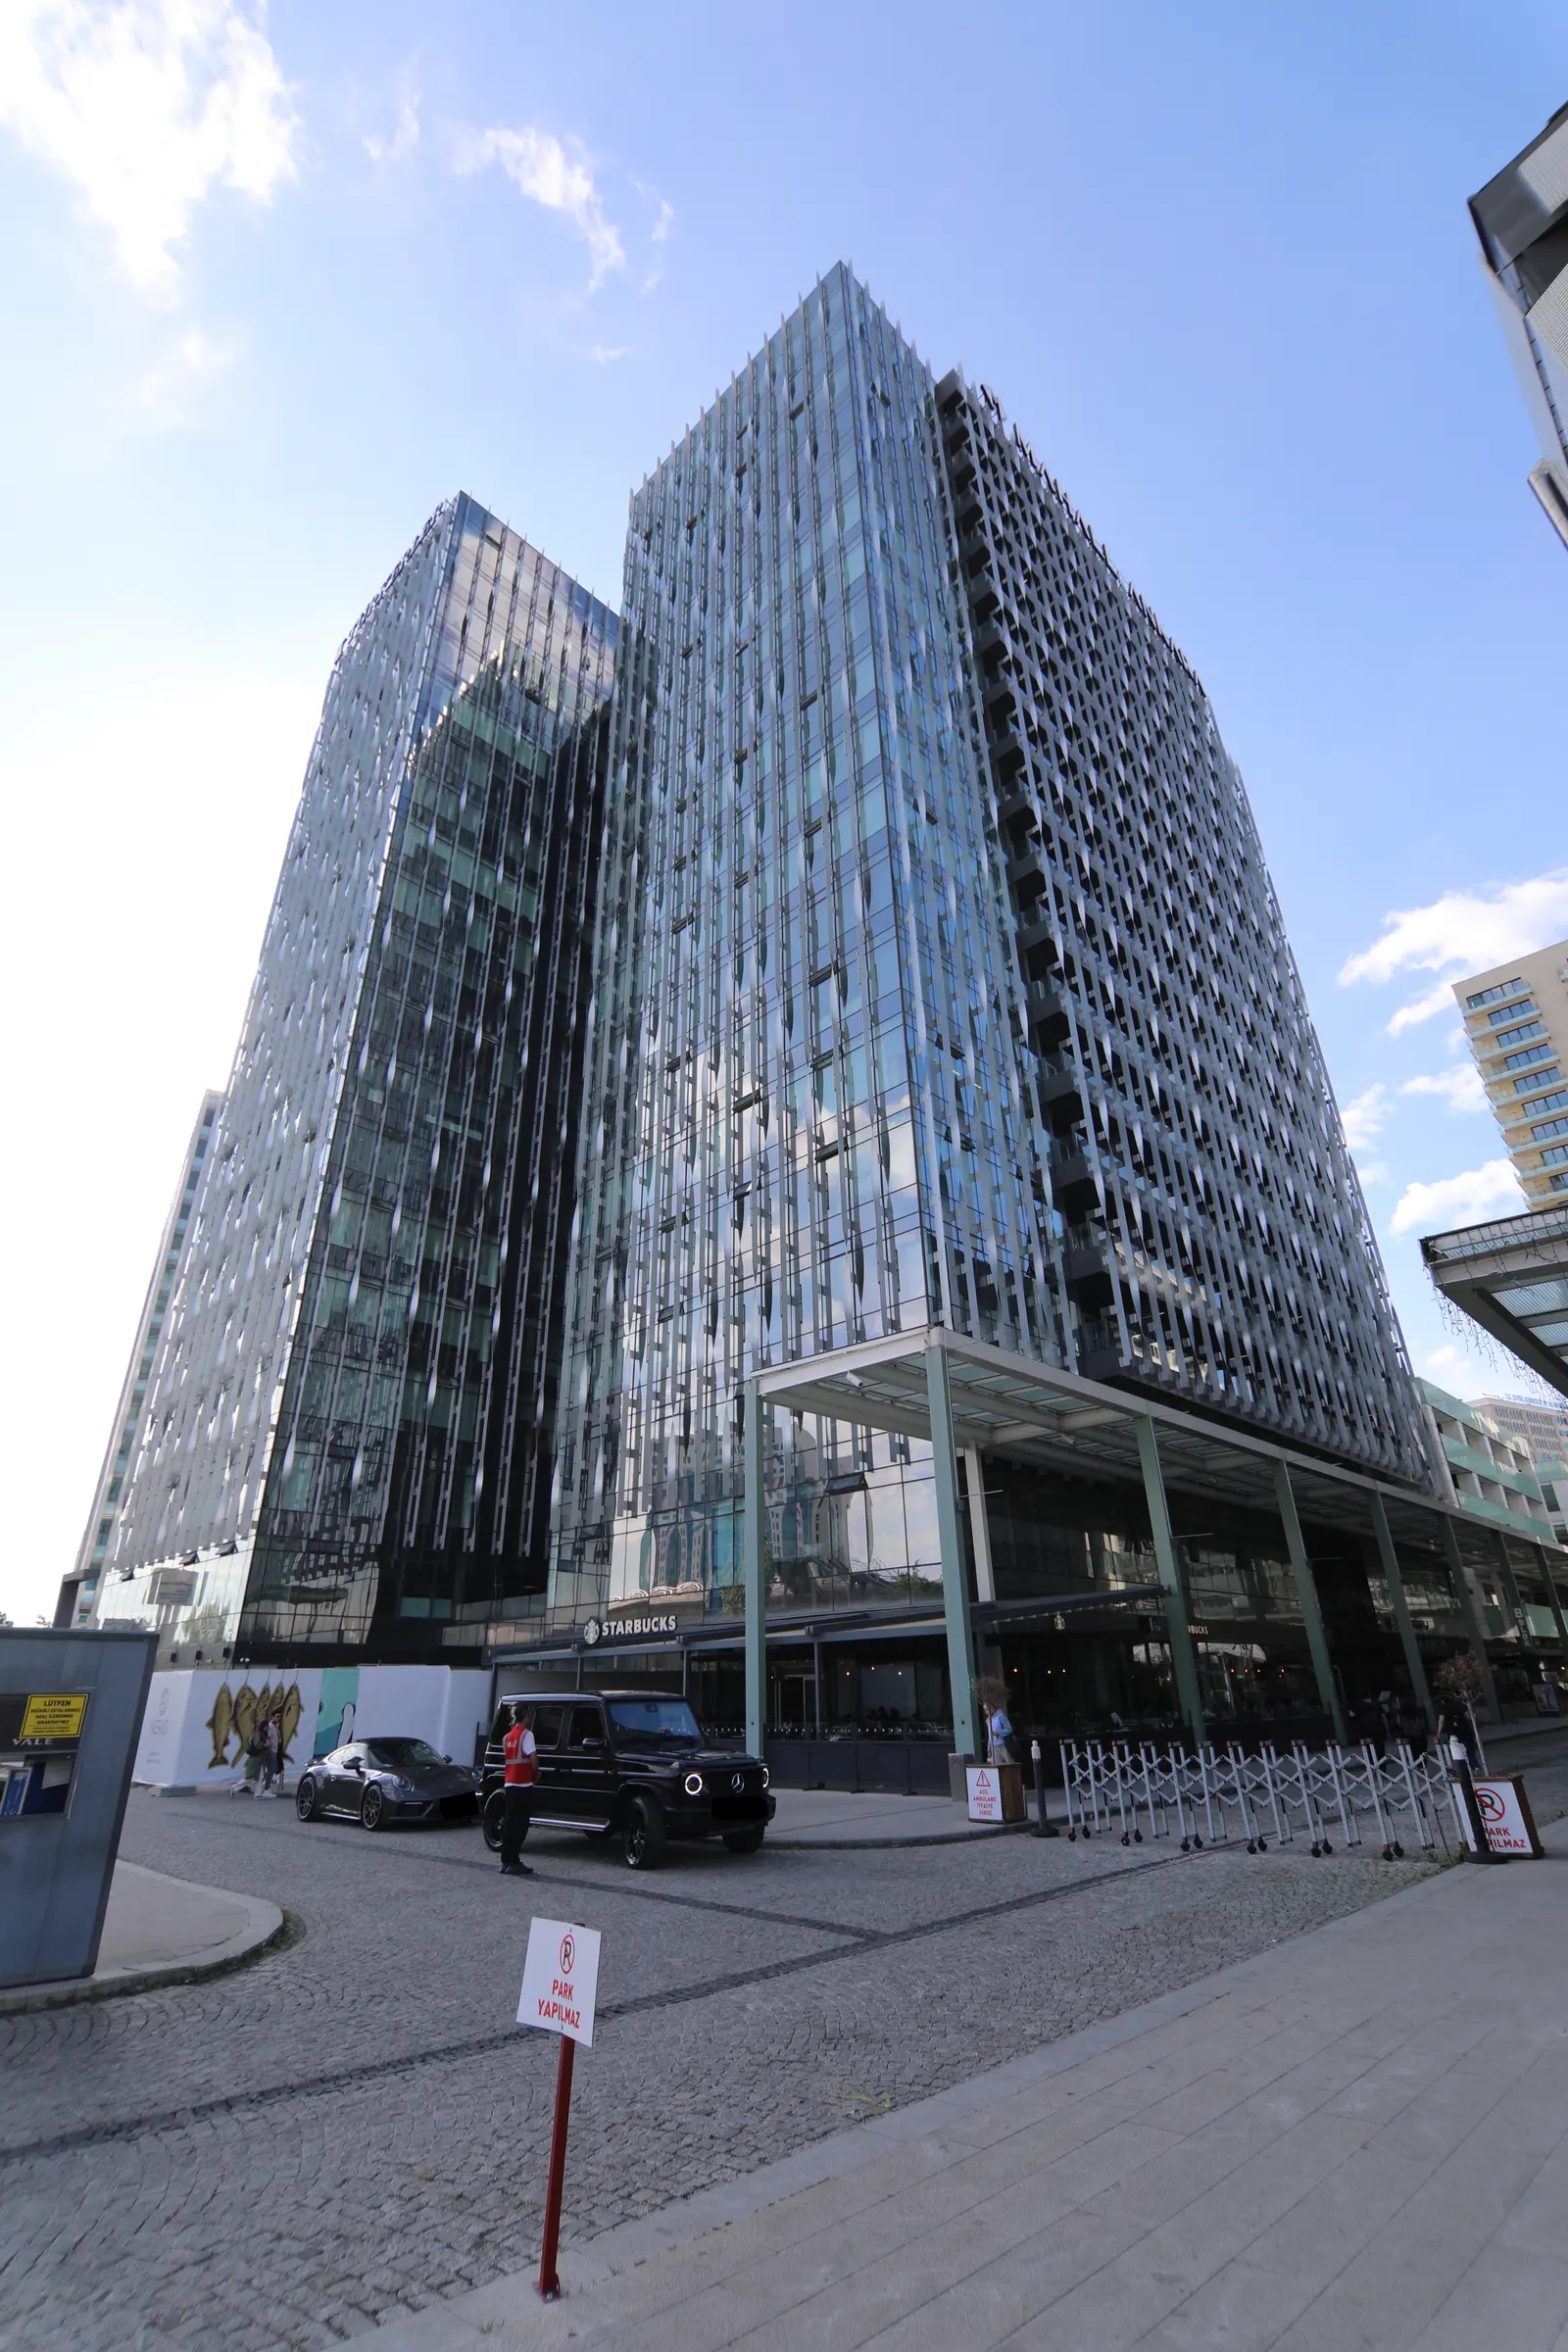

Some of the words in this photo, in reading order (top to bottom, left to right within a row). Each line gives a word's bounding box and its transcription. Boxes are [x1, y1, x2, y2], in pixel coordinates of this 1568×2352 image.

[602, 1615, 676, 1636] STARBUCKS
[1188, 1625, 1208, 1635] RBUCKS
[552, 1980, 574, 2001] PARK
[538, 1999, 581, 2030] YAPILMAZ
